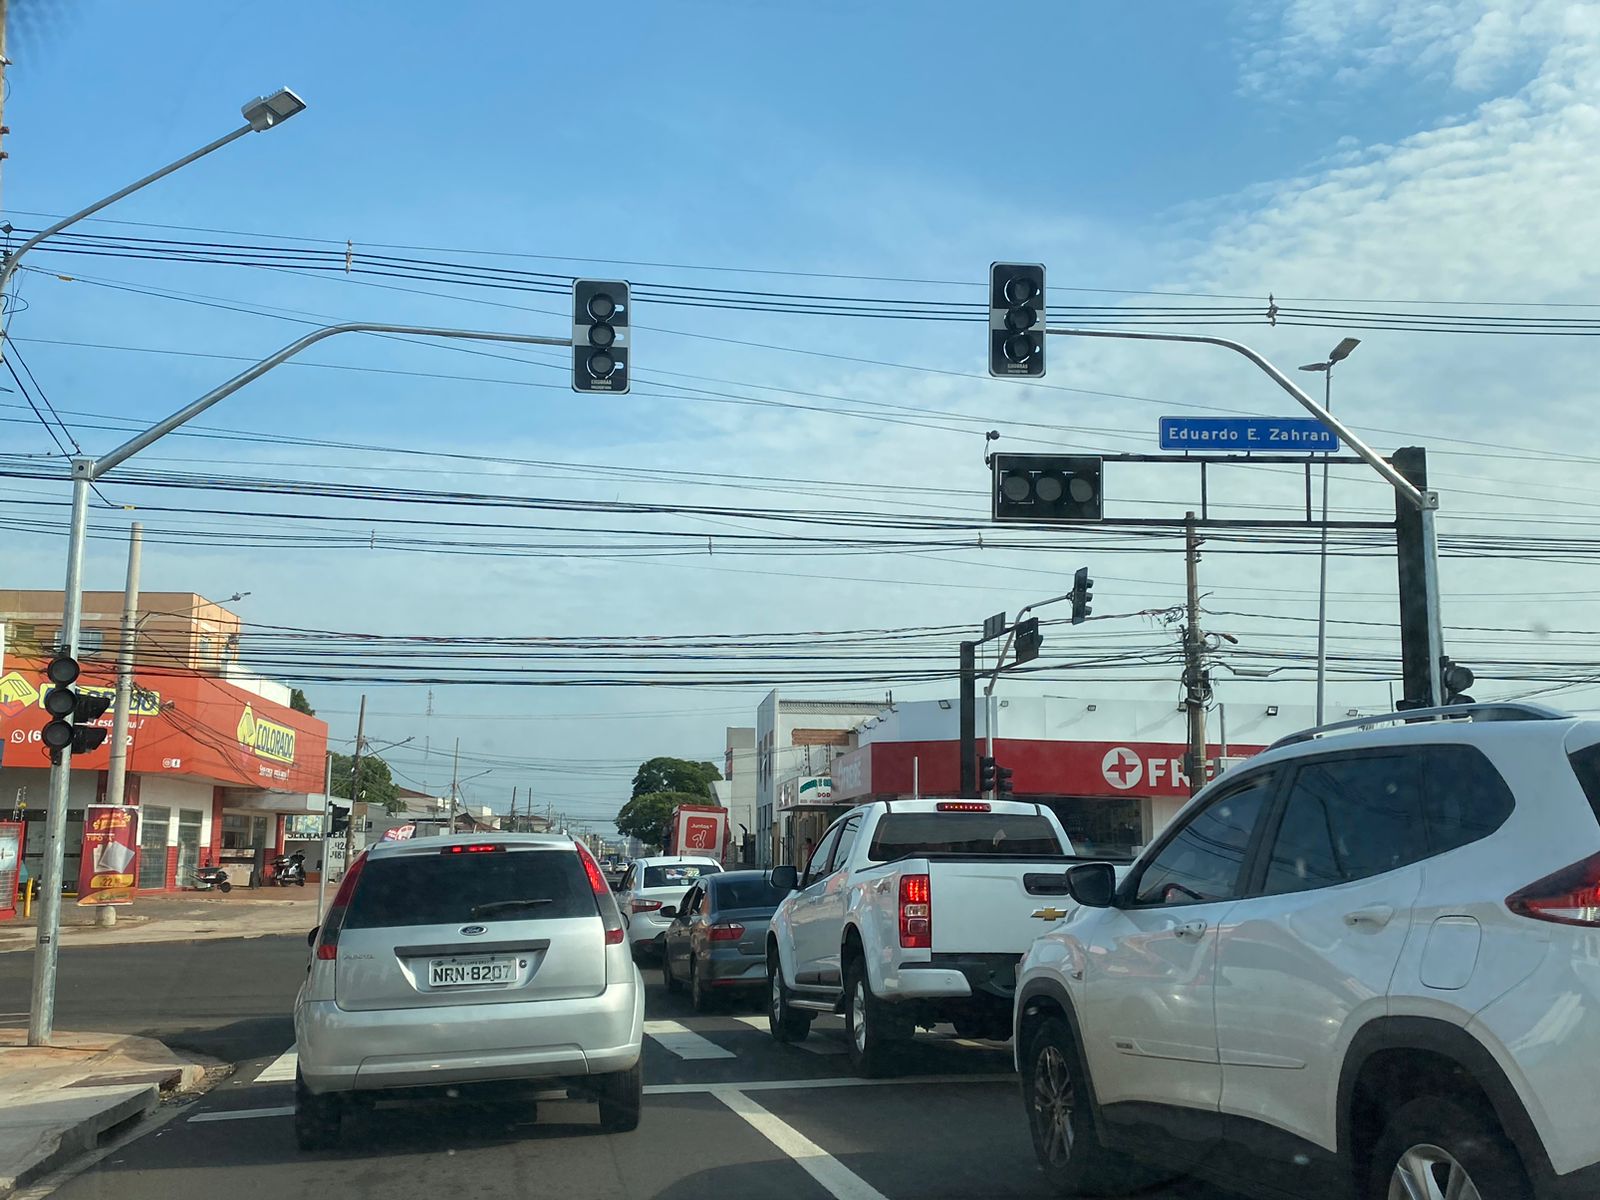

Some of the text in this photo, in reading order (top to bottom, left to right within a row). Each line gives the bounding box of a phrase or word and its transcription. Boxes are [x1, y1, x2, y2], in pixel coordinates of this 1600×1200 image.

[1169, 428, 1330, 441] Eduardo E. Zahran
[256, 724, 294, 759] COLORADO
